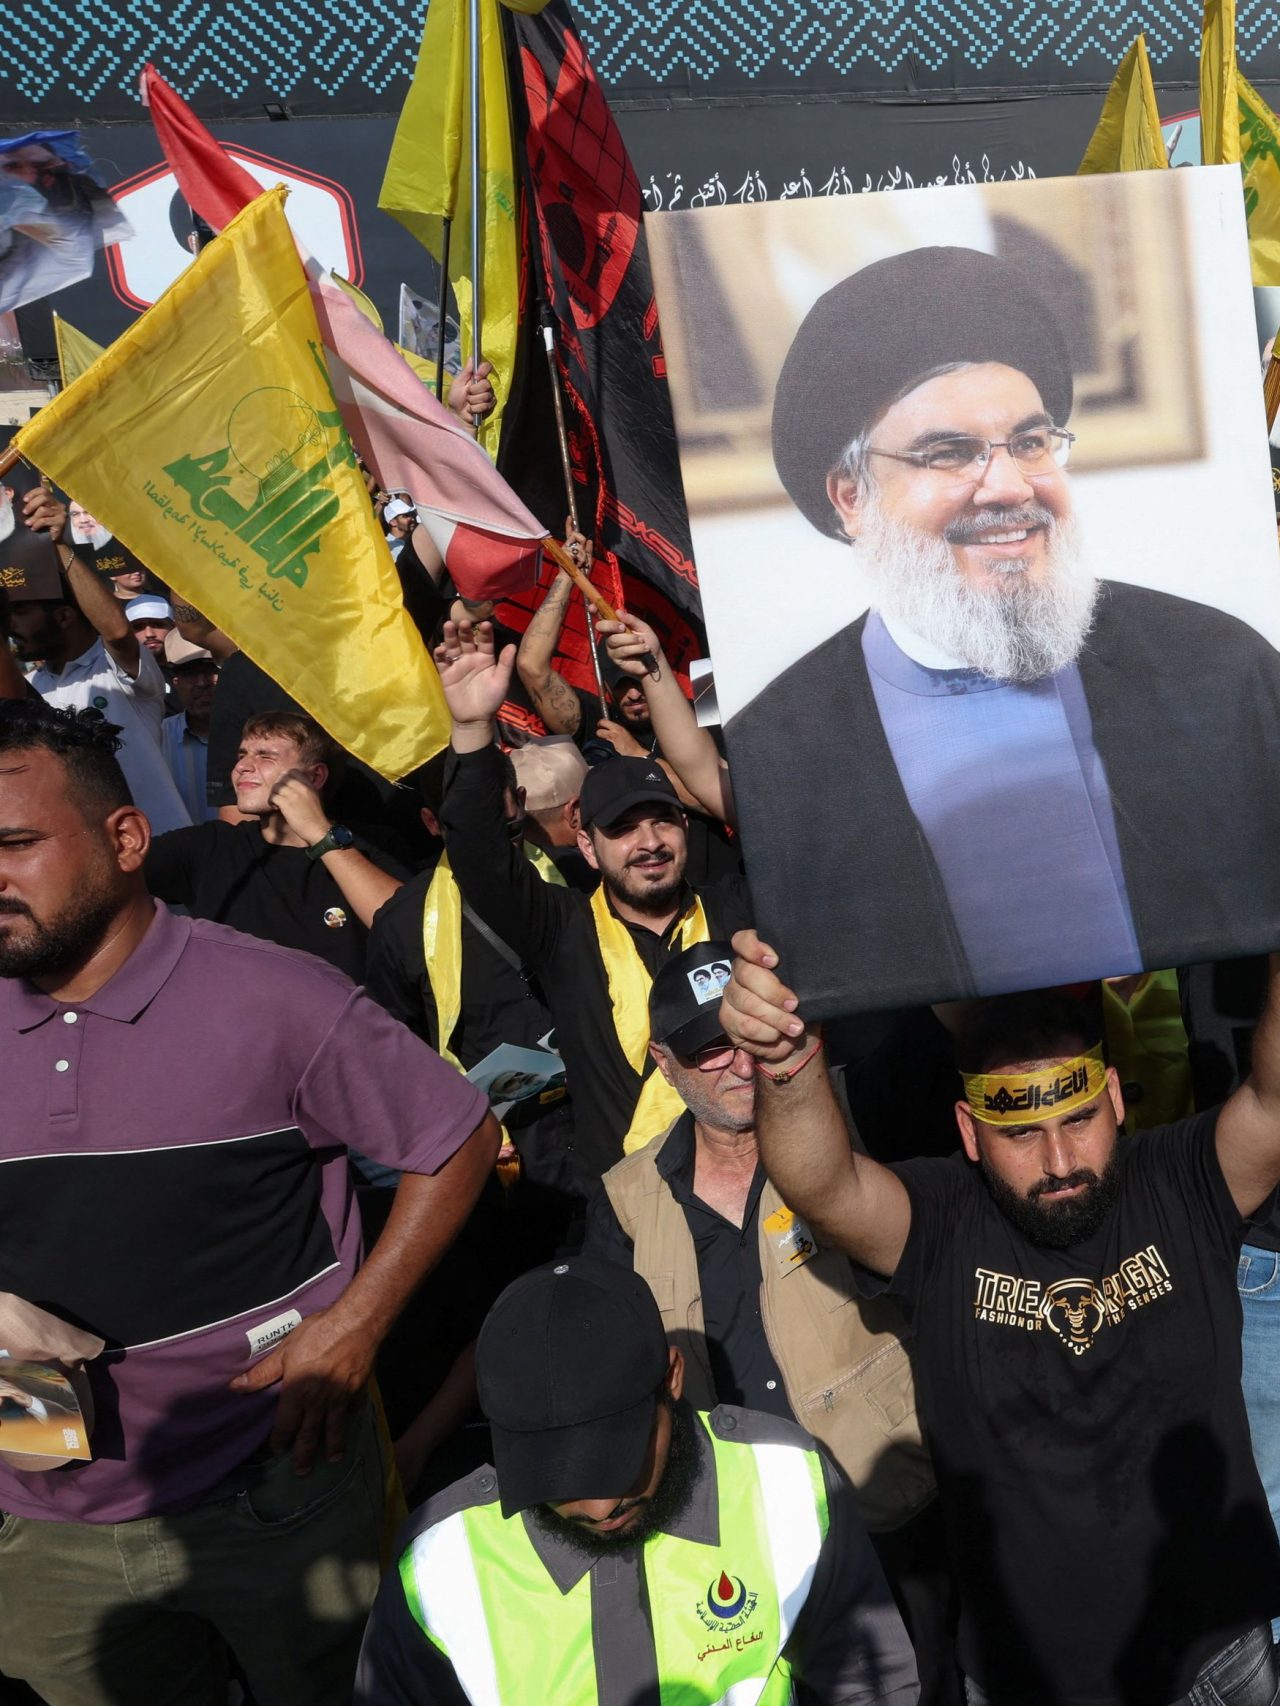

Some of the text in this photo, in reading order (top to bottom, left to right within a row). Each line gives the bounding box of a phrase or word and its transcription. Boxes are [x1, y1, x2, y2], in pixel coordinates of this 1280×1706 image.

[975, 1307, 1025, 1328] FASHION
[1106, 1308, 1126, 1328] THE
[1127, 1279, 1173, 1311] SENSES
